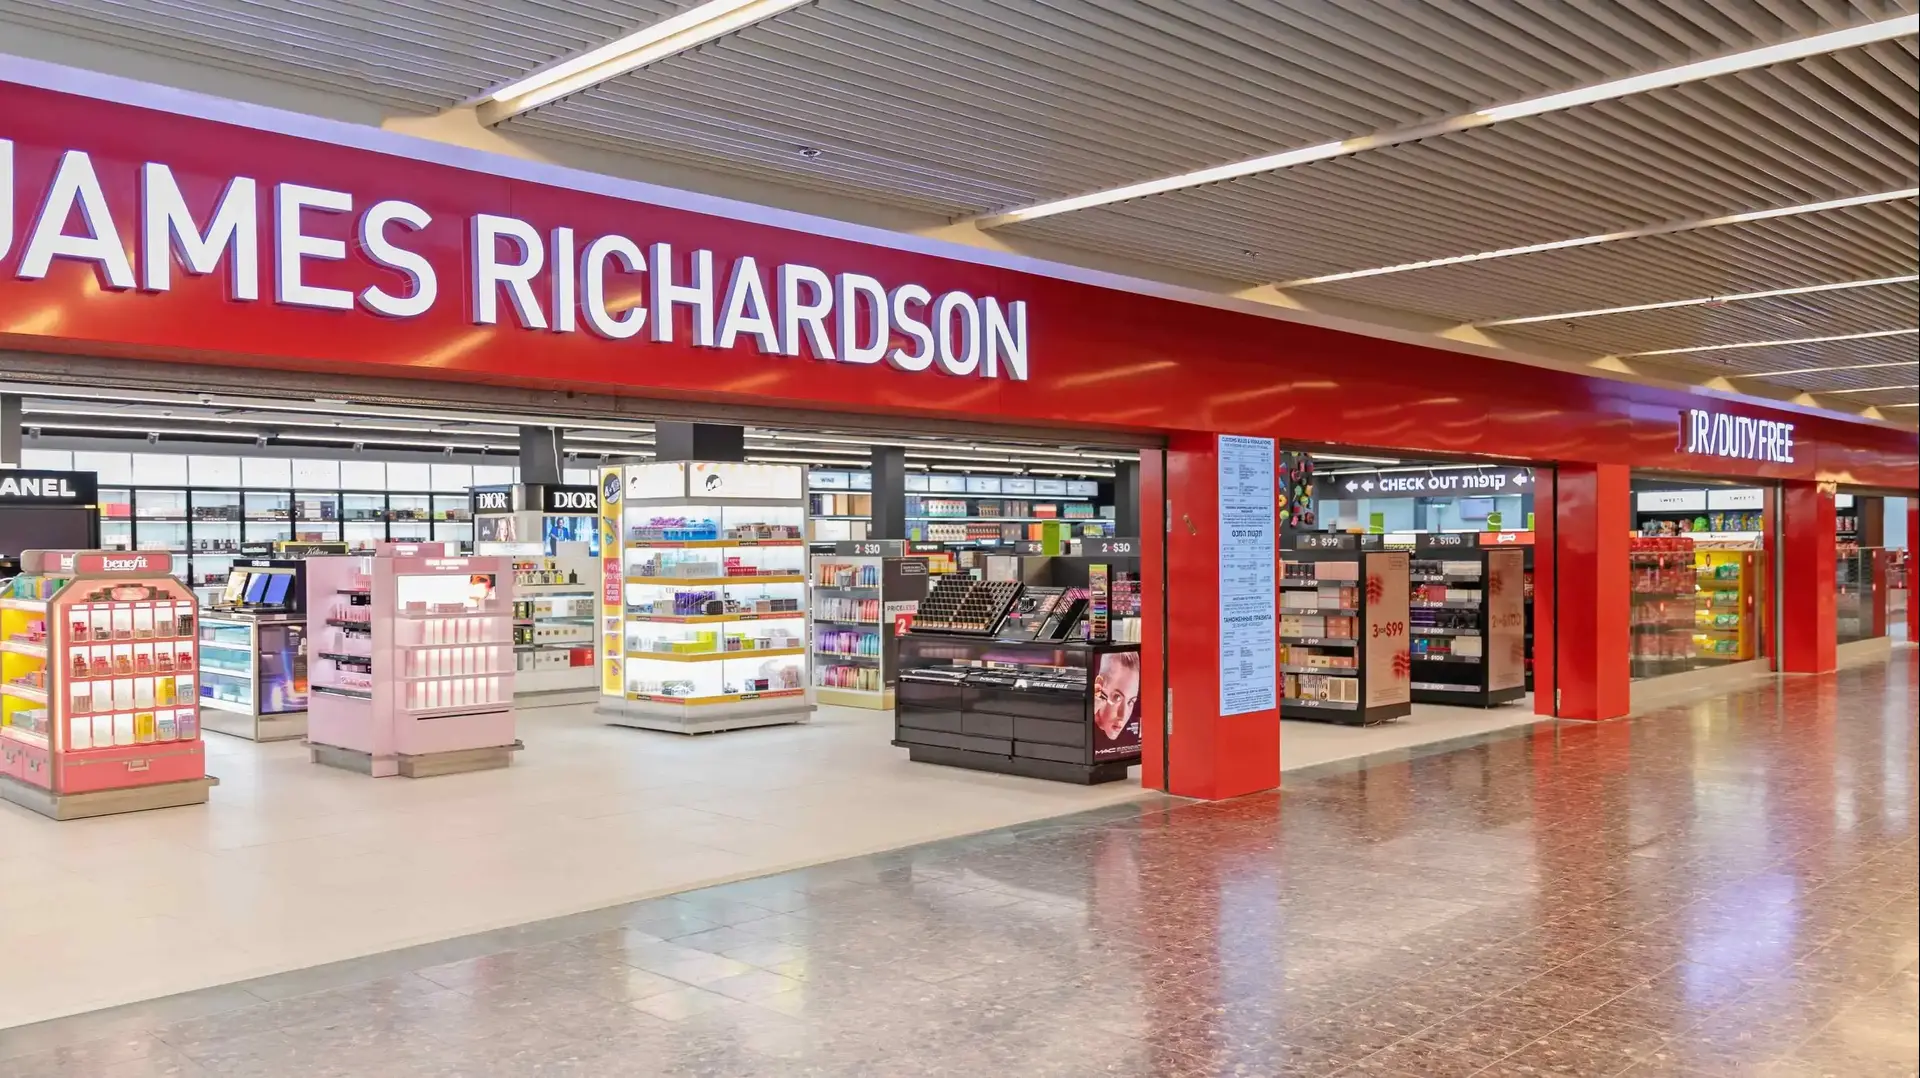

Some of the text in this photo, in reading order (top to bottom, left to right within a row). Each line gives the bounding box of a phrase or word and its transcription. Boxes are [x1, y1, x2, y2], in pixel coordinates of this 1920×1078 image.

[470, 213, 1028, 381] RICHARDSON
[1759, 420, 1794, 463] FREE
[1379, 476, 1458, 491] CHECK OUT
[1462, 475, 1506, 491] קופות
[480, 492, 507, 509] DIOR
[554, 492, 597, 508] DIOR
[855, 543, 880, 554] 2 $30
[1102, 543, 1130, 552] 2 $30
[1311, 538, 1338, 547] 3 $99
[1429, 537, 1461, 545] 2 $100
[102, 556, 148, 570] benefit
[898, 618, 906, 634] 2
[1372, 623, 1379, 638] 3
[1386, 621, 1404, 637] $99
